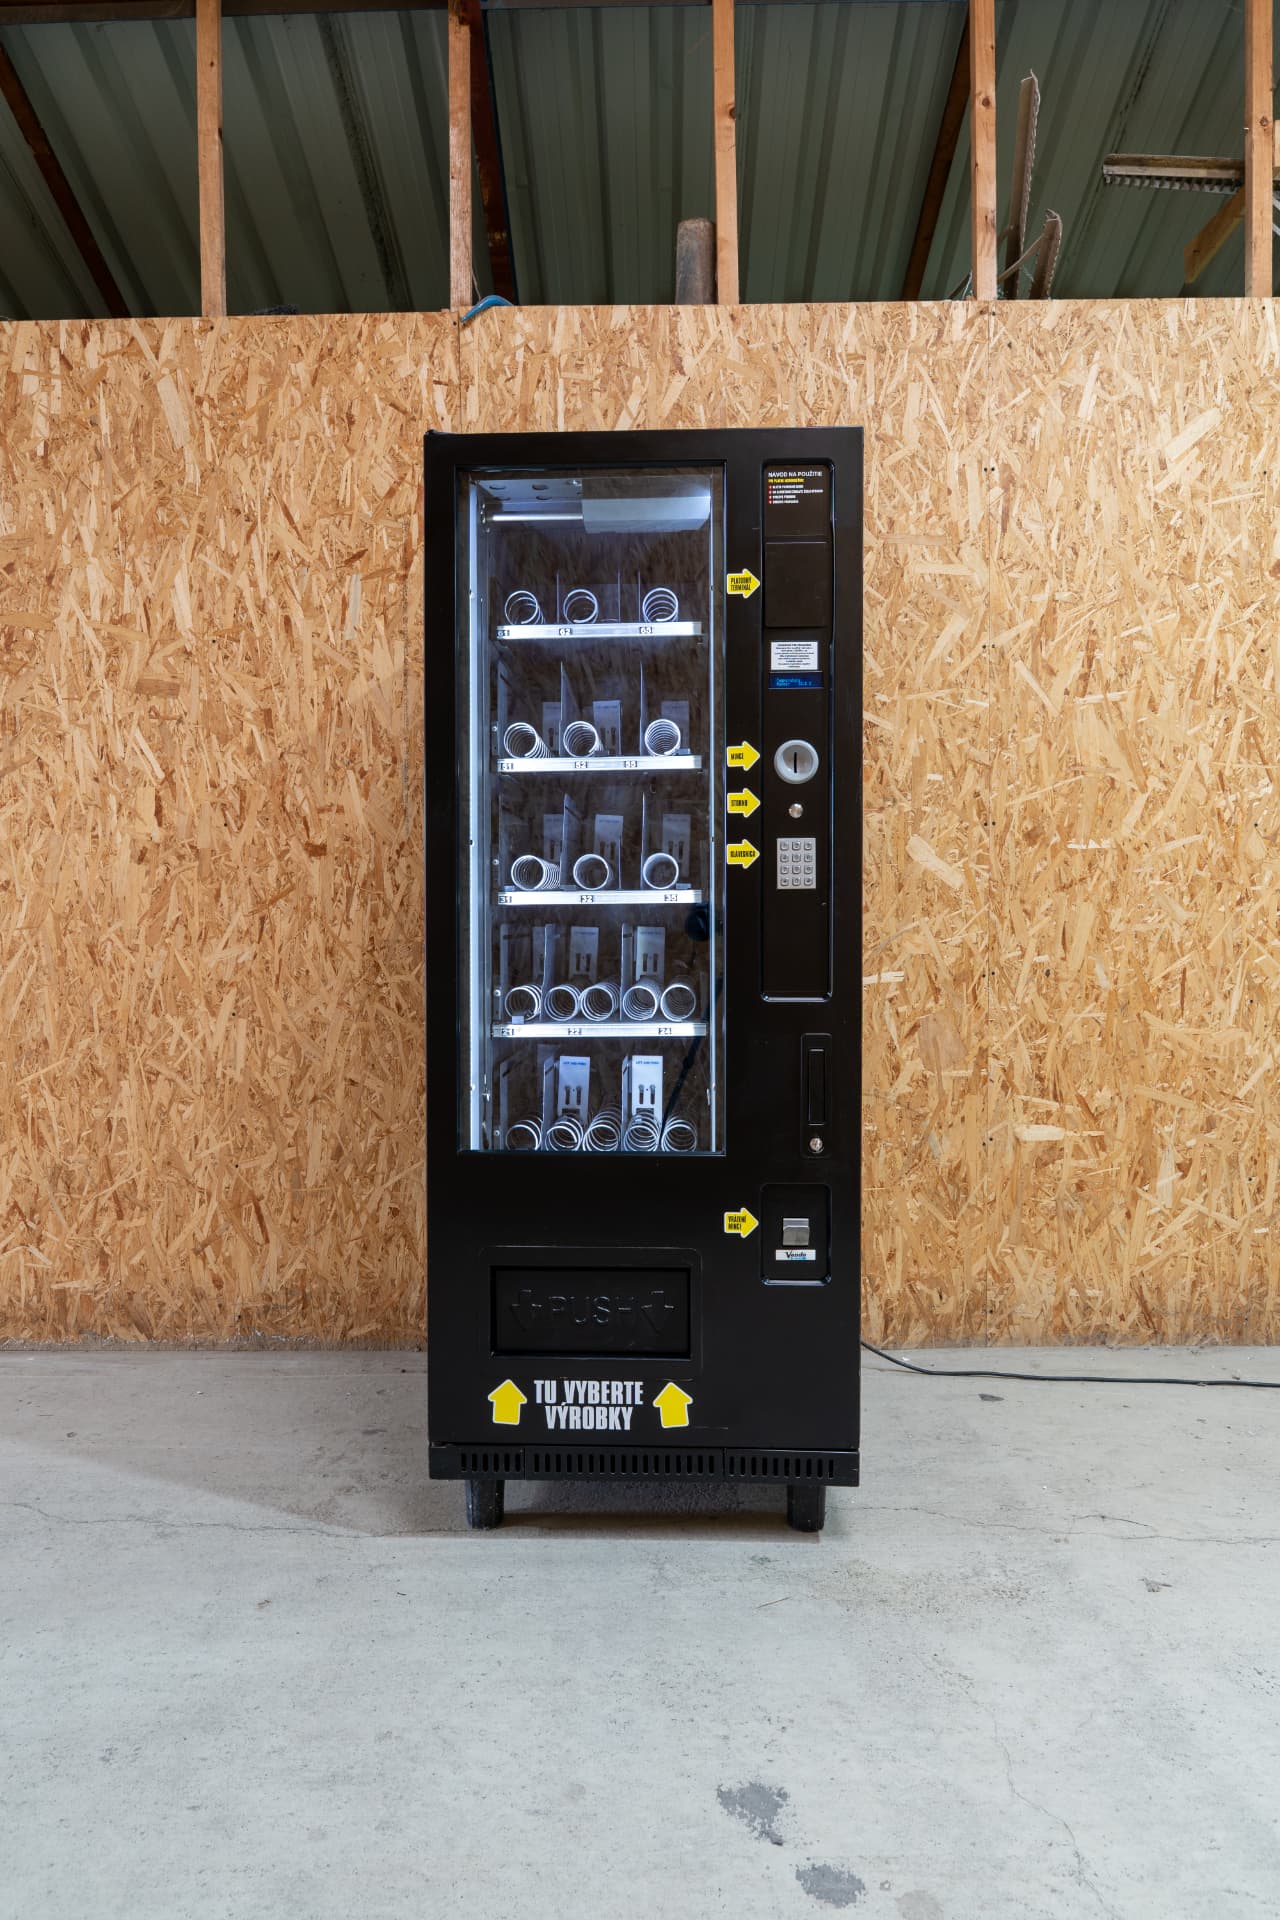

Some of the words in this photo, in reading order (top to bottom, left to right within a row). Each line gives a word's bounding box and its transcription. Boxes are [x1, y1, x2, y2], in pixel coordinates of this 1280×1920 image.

[548, 1296, 635, 1323] PUSH
[533, 1380, 557, 1404] TU
[563, 1380, 644, 1405] VYBERTE
[545, 1401, 633, 1430] VÝROBKY
